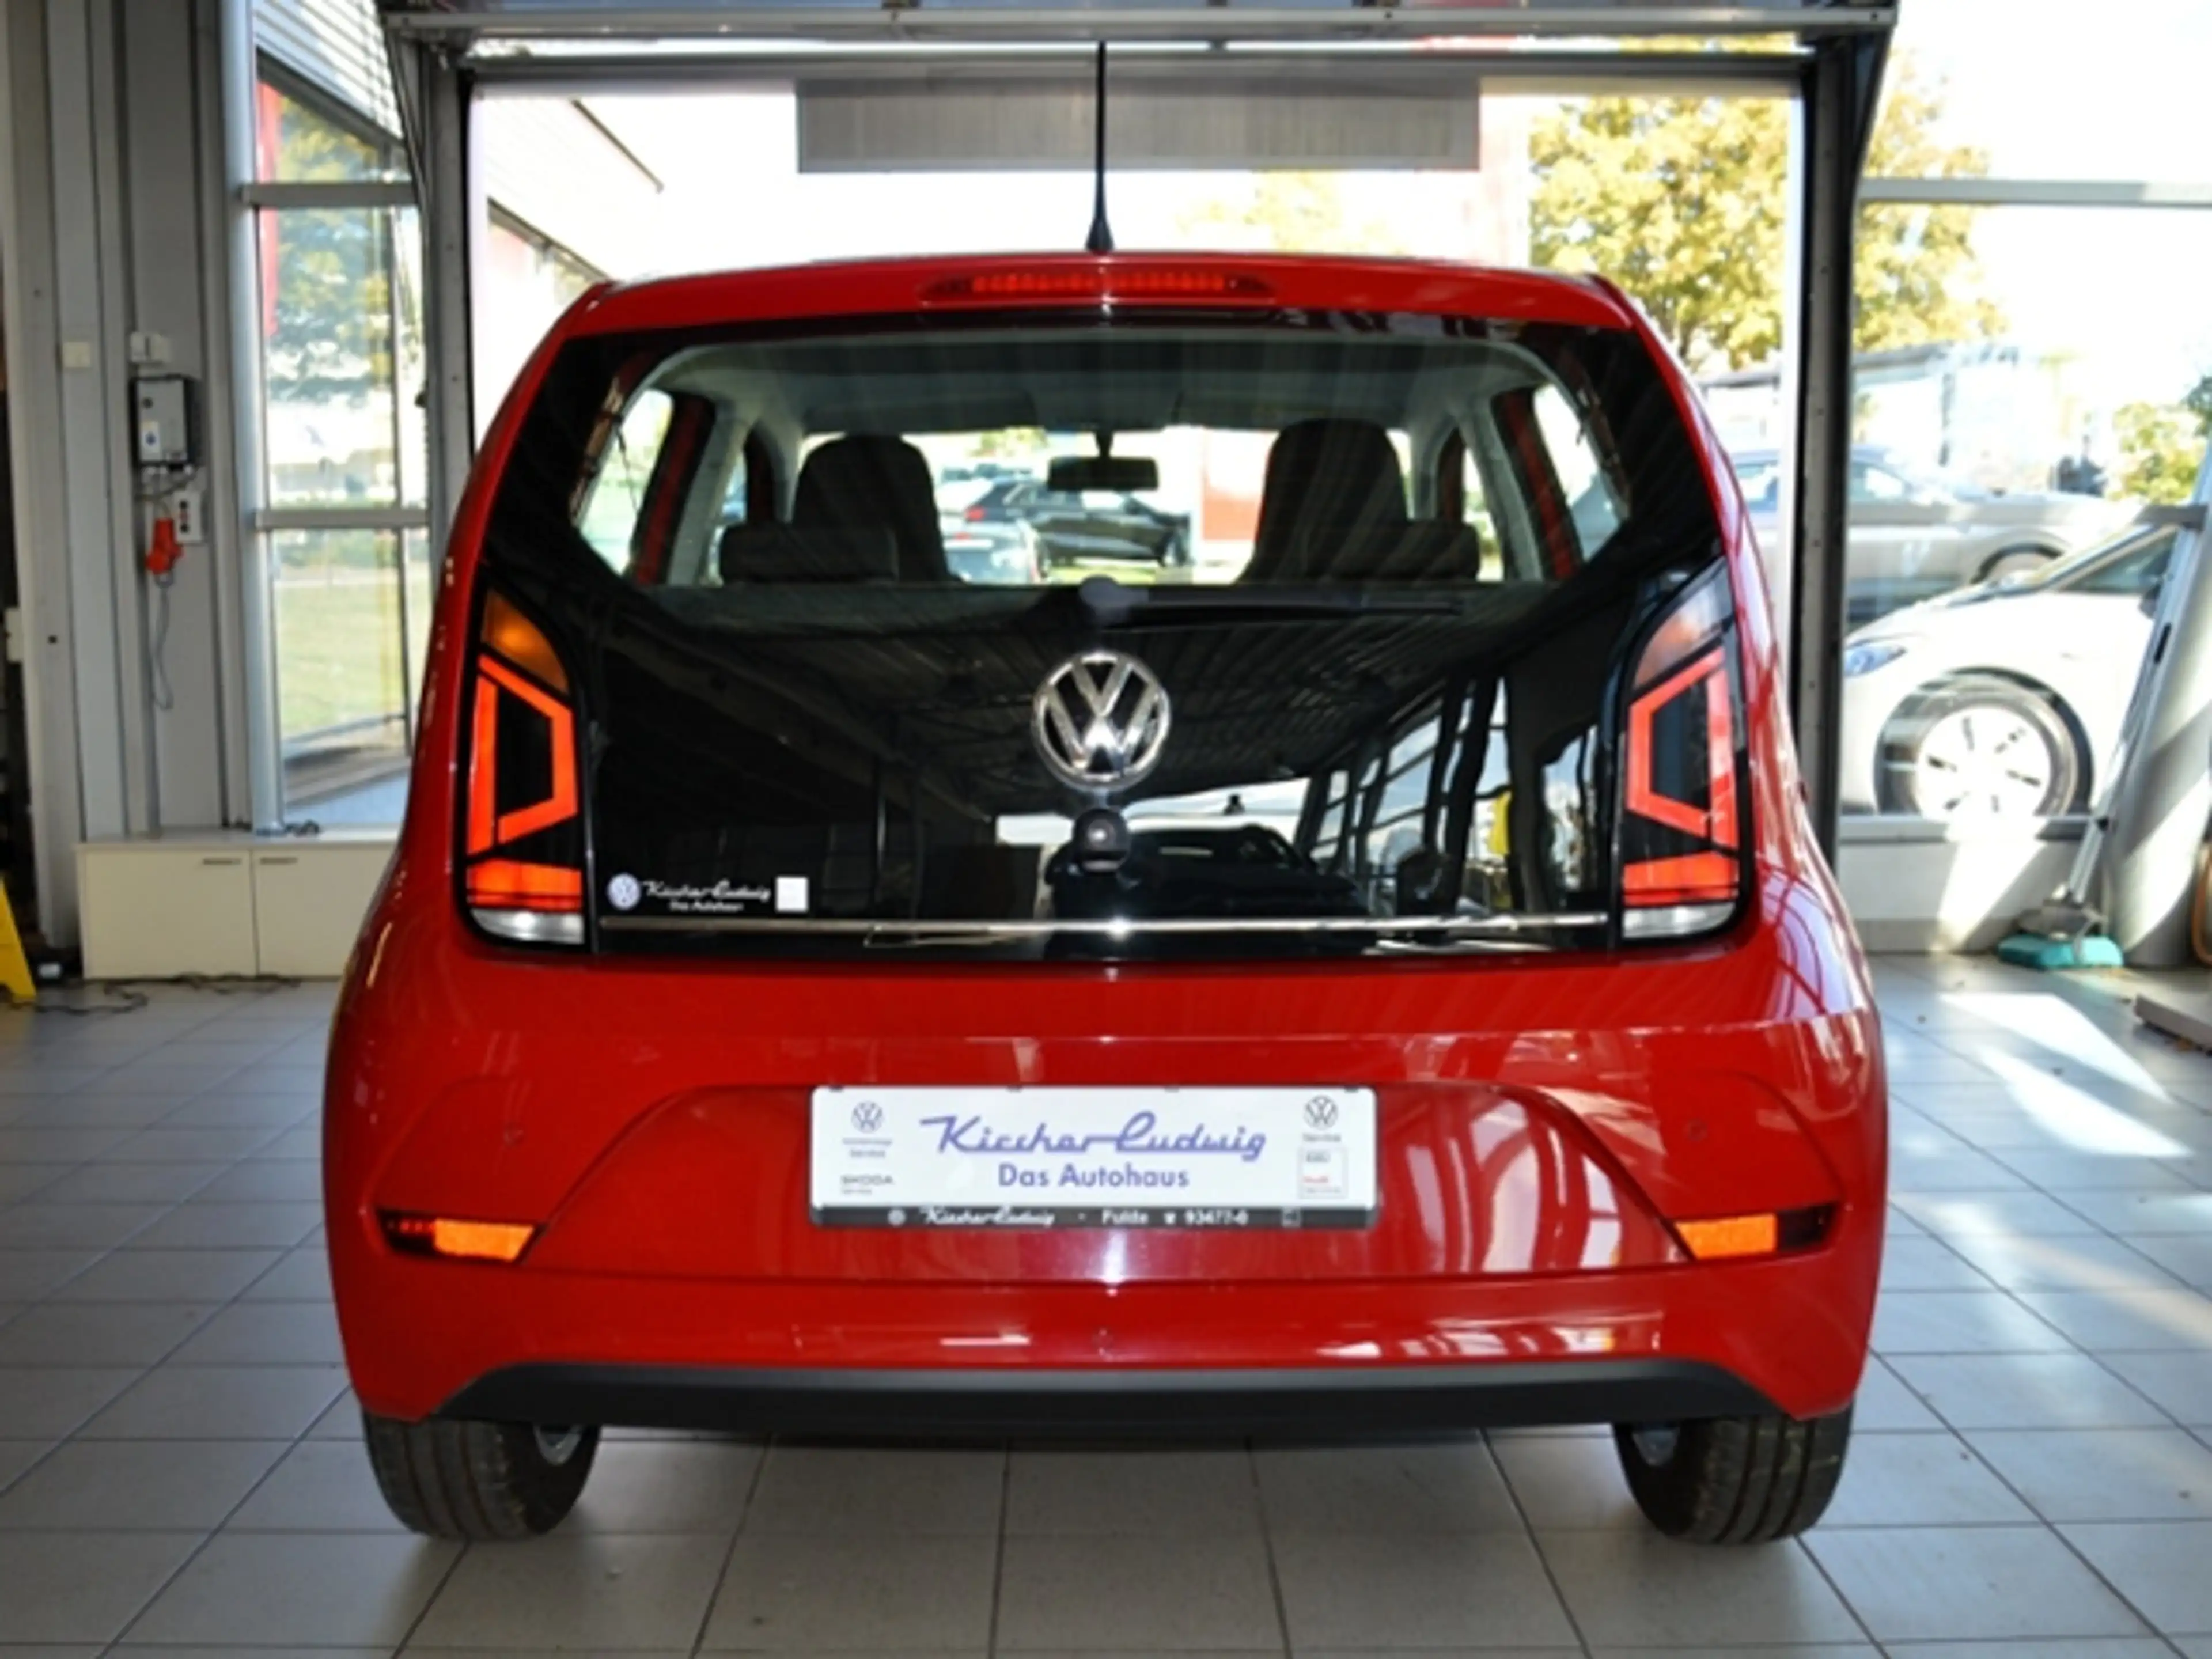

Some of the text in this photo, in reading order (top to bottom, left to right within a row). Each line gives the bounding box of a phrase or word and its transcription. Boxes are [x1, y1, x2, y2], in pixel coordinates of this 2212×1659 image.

[1115, 1111, 1267, 1162] Ludwig
[998, 1161, 1190, 1187] Das Autohaus
